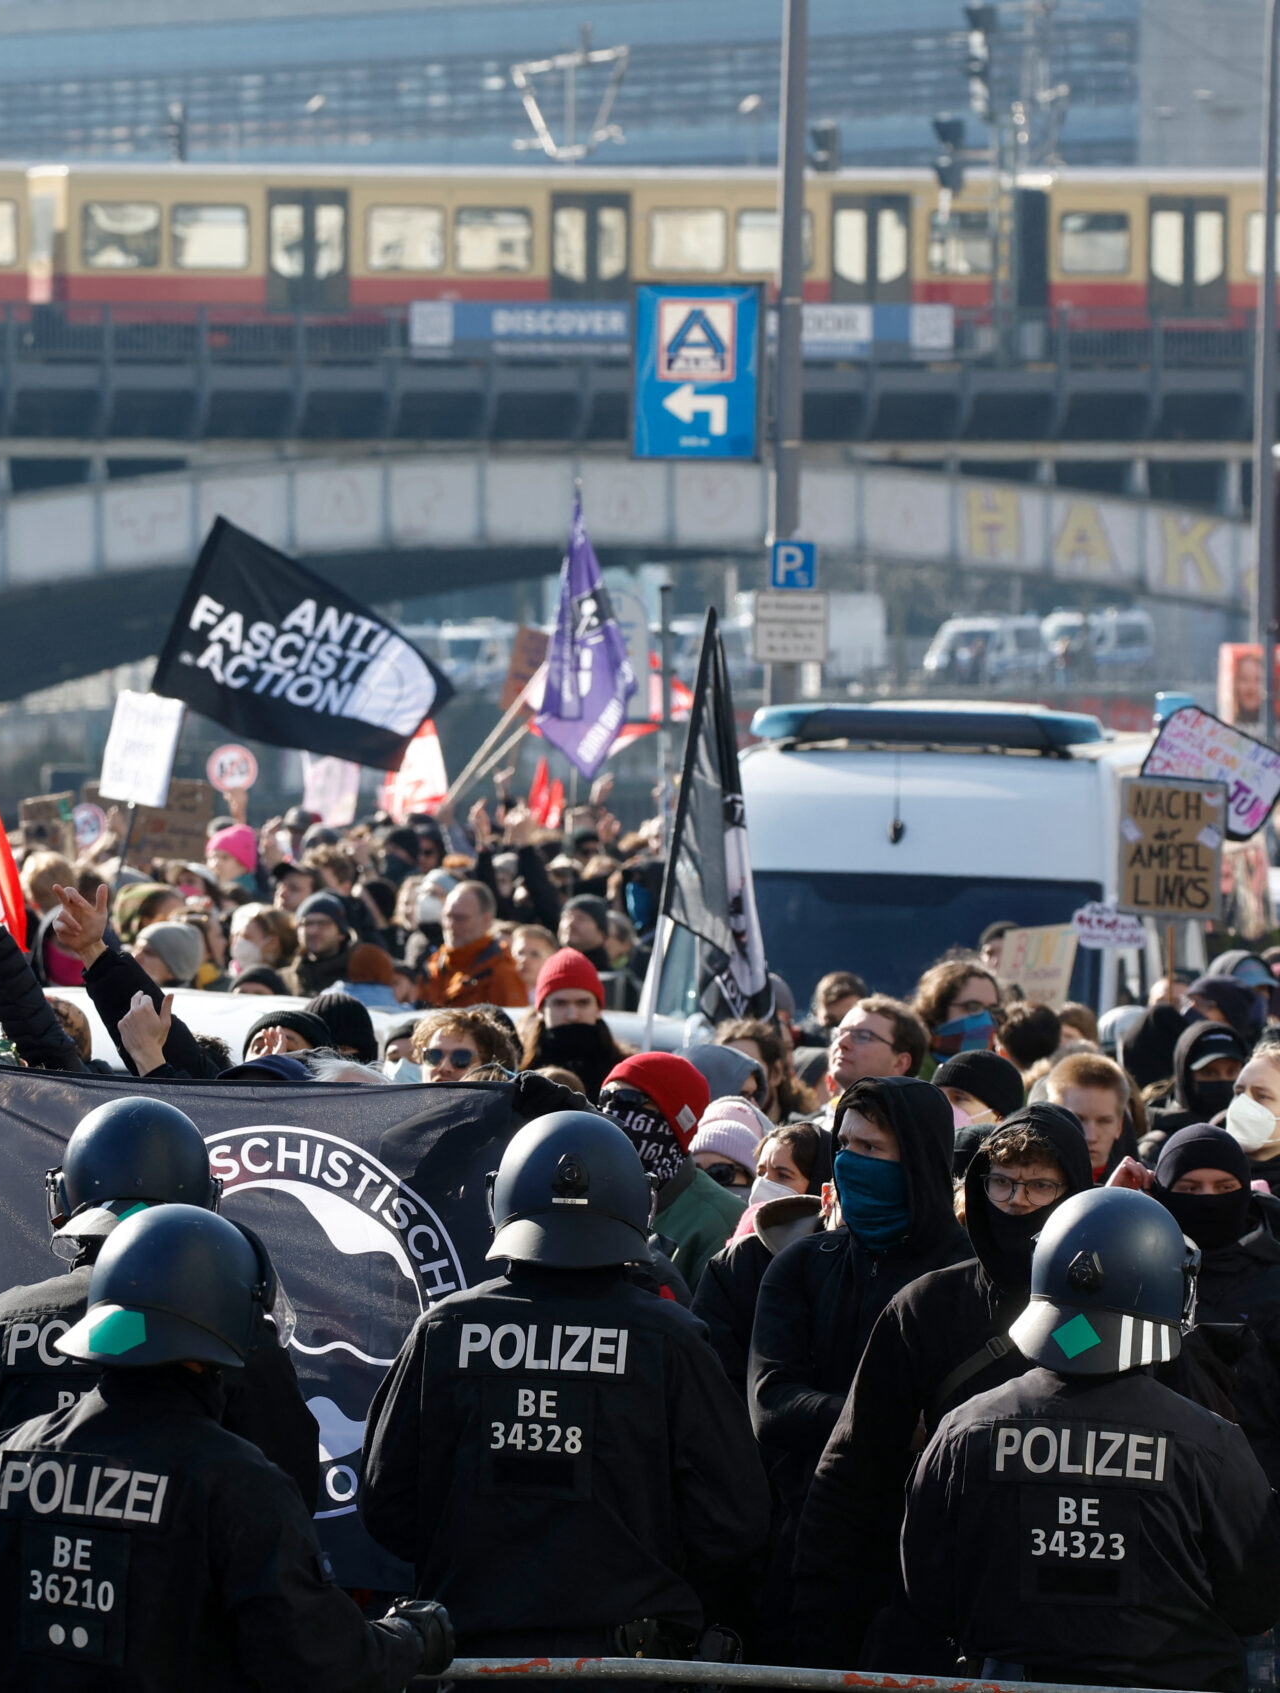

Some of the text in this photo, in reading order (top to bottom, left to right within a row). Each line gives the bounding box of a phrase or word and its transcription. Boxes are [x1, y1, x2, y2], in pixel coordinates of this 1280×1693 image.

[491, 309, 626, 335] DISCOVER
[966, 488, 1257, 594] HAK
[776, 546, 804, 584] P
[189, 595, 369, 683] FASCIST
[282, 599, 392, 656] ANTI
[197, 642, 353, 716] ACTION
[1134, 790, 1201, 820] NACH
[1129, 843, 1209, 872] AMPEL
[1134, 875, 1210, 909] LINKS
[209, 1137, 457, 1307] SCHISTISCH
[459, 1323, 629, 1375] POLIZEI
[517, 1388, 558, 1419] BE
[490, 1421, 583, 1454] 34328
[995, 1426, 1168, 1482] POLIZEI
[0, 1460, 169, 1524] POLIZEI
[1058, 1496, 1100, 1527] BE
[52, 1535, 93, 1572] BE
[1031, 1528, 1126, 1561] 34323
[29, 1569, 115, 1613] 36210
